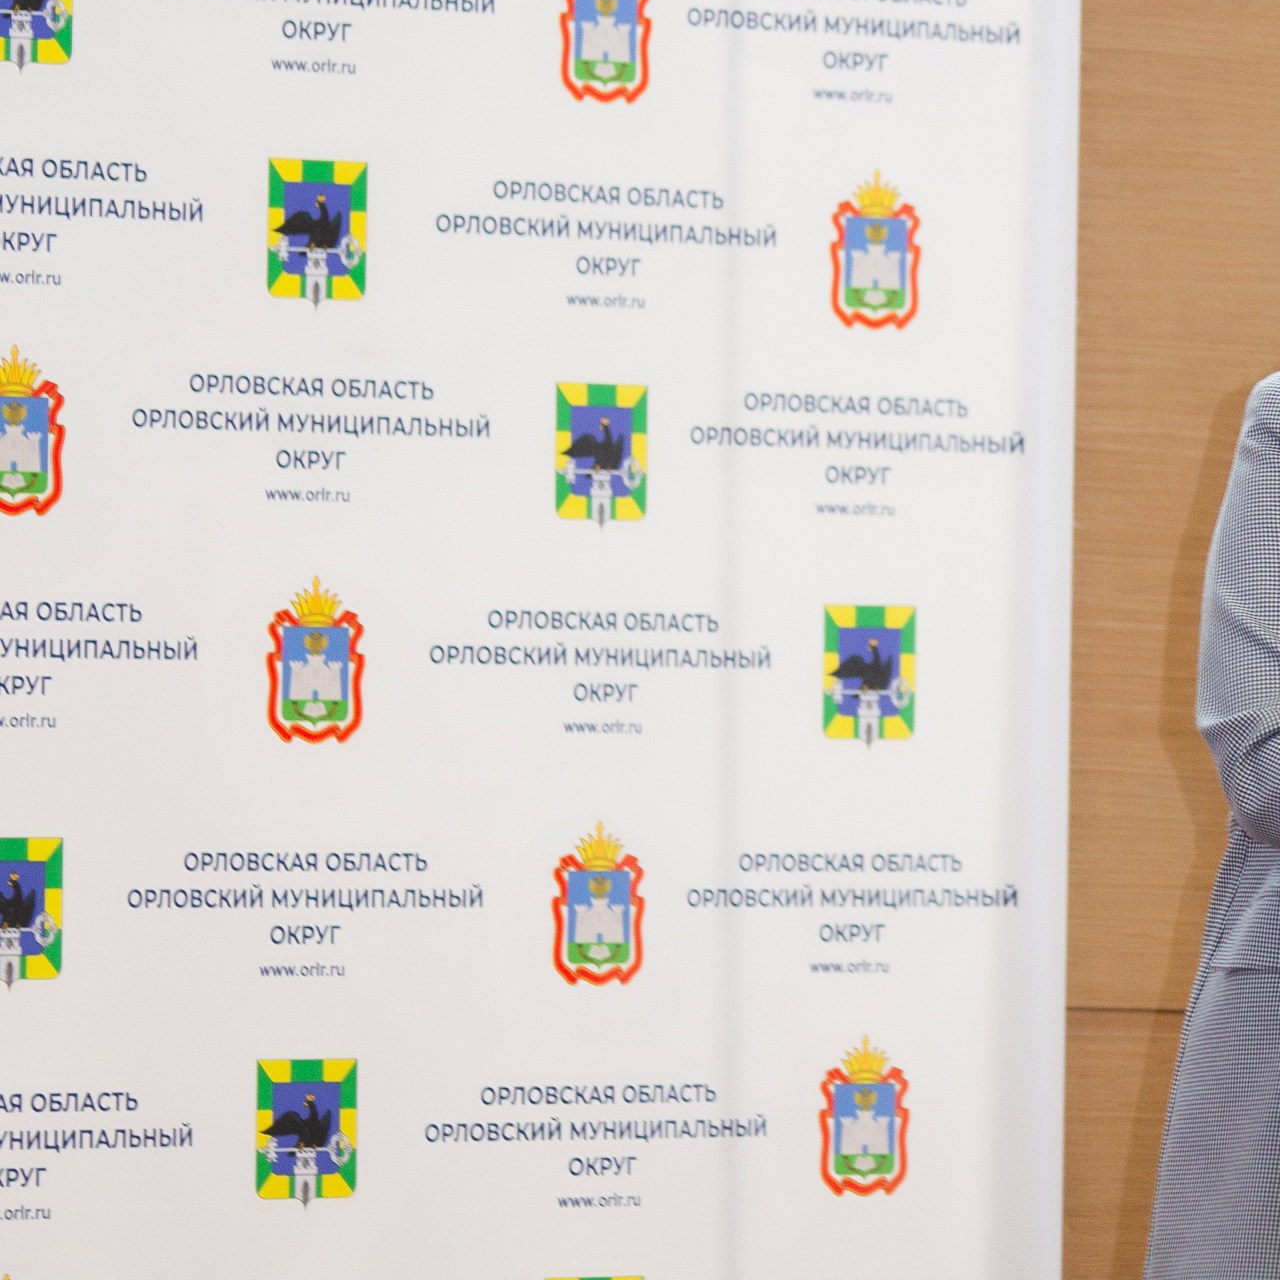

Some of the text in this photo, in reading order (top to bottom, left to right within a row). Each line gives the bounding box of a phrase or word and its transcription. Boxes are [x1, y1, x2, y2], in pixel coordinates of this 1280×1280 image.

[281, 18, 353, 43] ОКРУГ
[686, 6, 1021, 45] ОРЛОВСКИЙ МУНИЦИПАЛЬНЫЙ
[822, 50, 889, 72] ОКРУГ
[40, 158, 148, 184] ОБЛАСТЬ
[492, 179, 725, 211] ОРЛОВСКАЯ ОБЛАСТЬ
[0, 193, 204, 223] УНИЦИПАЛЬНЫЙ
[0, 230, 58, 253] КРУГ
[435, 213, 777, 248] ОРЛОВСКИЙ МУНИЦИПАЛЬНЫЙ
[575, 255, 642, 277] ОКРУГ
[188, 372, 435, 401] ОРЛОВСКАЯ ОБЛАСТЬ
[743, 391, 969, 419] ОРЛОВСКАЯ ОБЛАСТЬ
[131, 406, 491, 439] ОРЛОВСКИЙ МУНИЦИПАЛЬНЫЙ
[690, 425, 1026, 455] ОРЛОВСКИЙ МУНИЦИПАЛЬНЫЙ
[275, 448, 347, 471] ОКРУГ
[825, 464, 892, 485] ОКРУГ
[35, 600, 143, 624] ОБЛАСТЬ
[487, 609, 720, 634] ОРЛОВСКАЯ ОБЛАСТЬ
[0, 635, 199, 663] УНИЦИПАЛЬНЫЙ
[428, 641, 772, 671] ОРЛОВСКИЙ МУНИЦИПАЛЬНЫЙ
[0, 674, 53, 697] КРУГ
[572, 681, 639, 703] ОКРУГ
[183, 851, 429, 873] ОРЛОВСКАЯ ОБЛАСТЬ
[738, 852, 963, 873] ОРЛОВСКАЯ ОБЛАСТЬ
[126, 883, 484, 913] ОРЛОВСКИЙ МУНИЦИПАЛЬНЫЙ
[686, 883, 1019, 910] ОРЛОВСКИЙ МУНИЦИПАЛЬНЫЙ
[269, 924, 342, 946] ОКРУГ
[818, 922, 886, 944] ОКРУГ
[29, 1091, 139, 1114] ОБЛАСТЬ
[479, 1083, 717, 1107] ОРЛОВСКАЯ ОБЛАСТЬ
[424, 1113, 768, 1144] ОРЛОВСКИЙ МУНИЦИПАЛЬНЫЙ
[0, 1166, 48, 1189] РУГ
[567, 1155, 638, 1178] ОКРУГ
